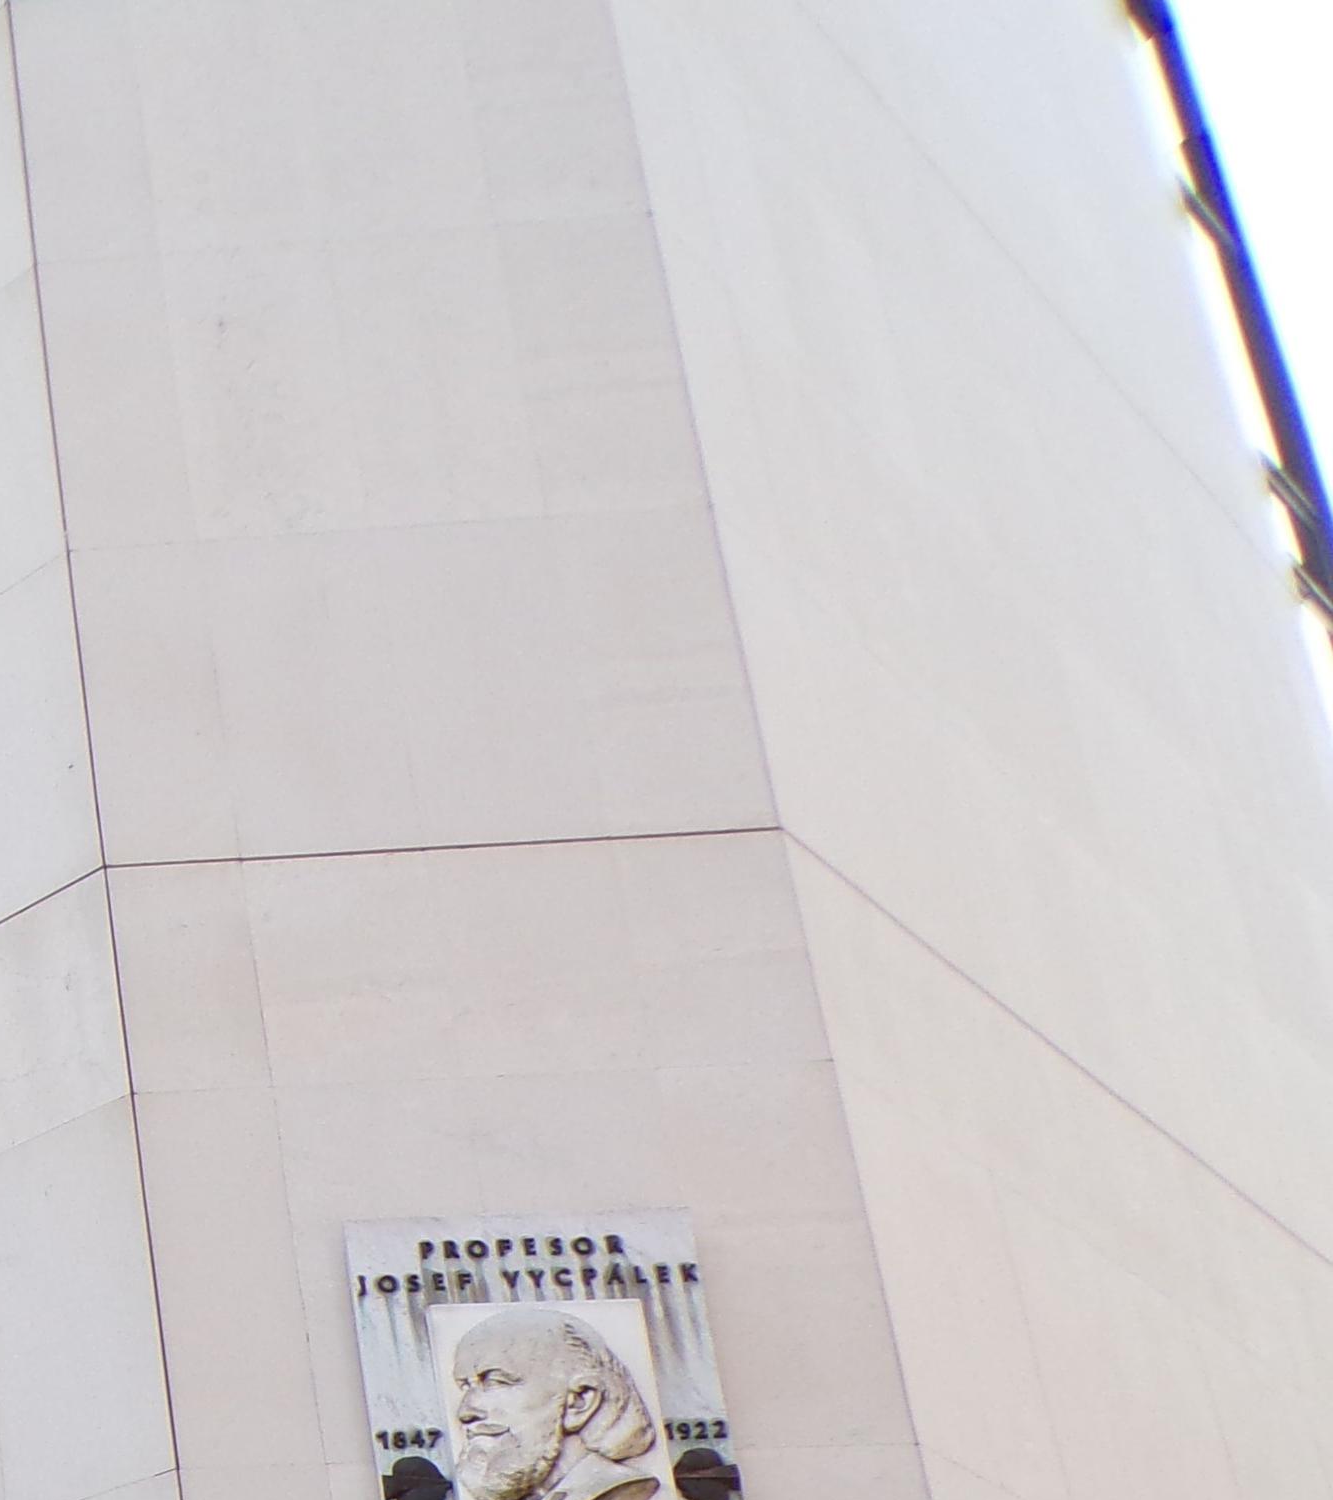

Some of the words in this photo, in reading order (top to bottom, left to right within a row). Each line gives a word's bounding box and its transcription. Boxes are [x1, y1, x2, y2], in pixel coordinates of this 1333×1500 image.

[419, 1234, 625, 1260] PROFESOR
[357, 1272, 472, 1298] JOSEF
[500, 1261, 699, 1289] VYCPÁLEK
[375, 1428, 444, 1451] 1847
[664, 1419, 729, 1441] 1922
